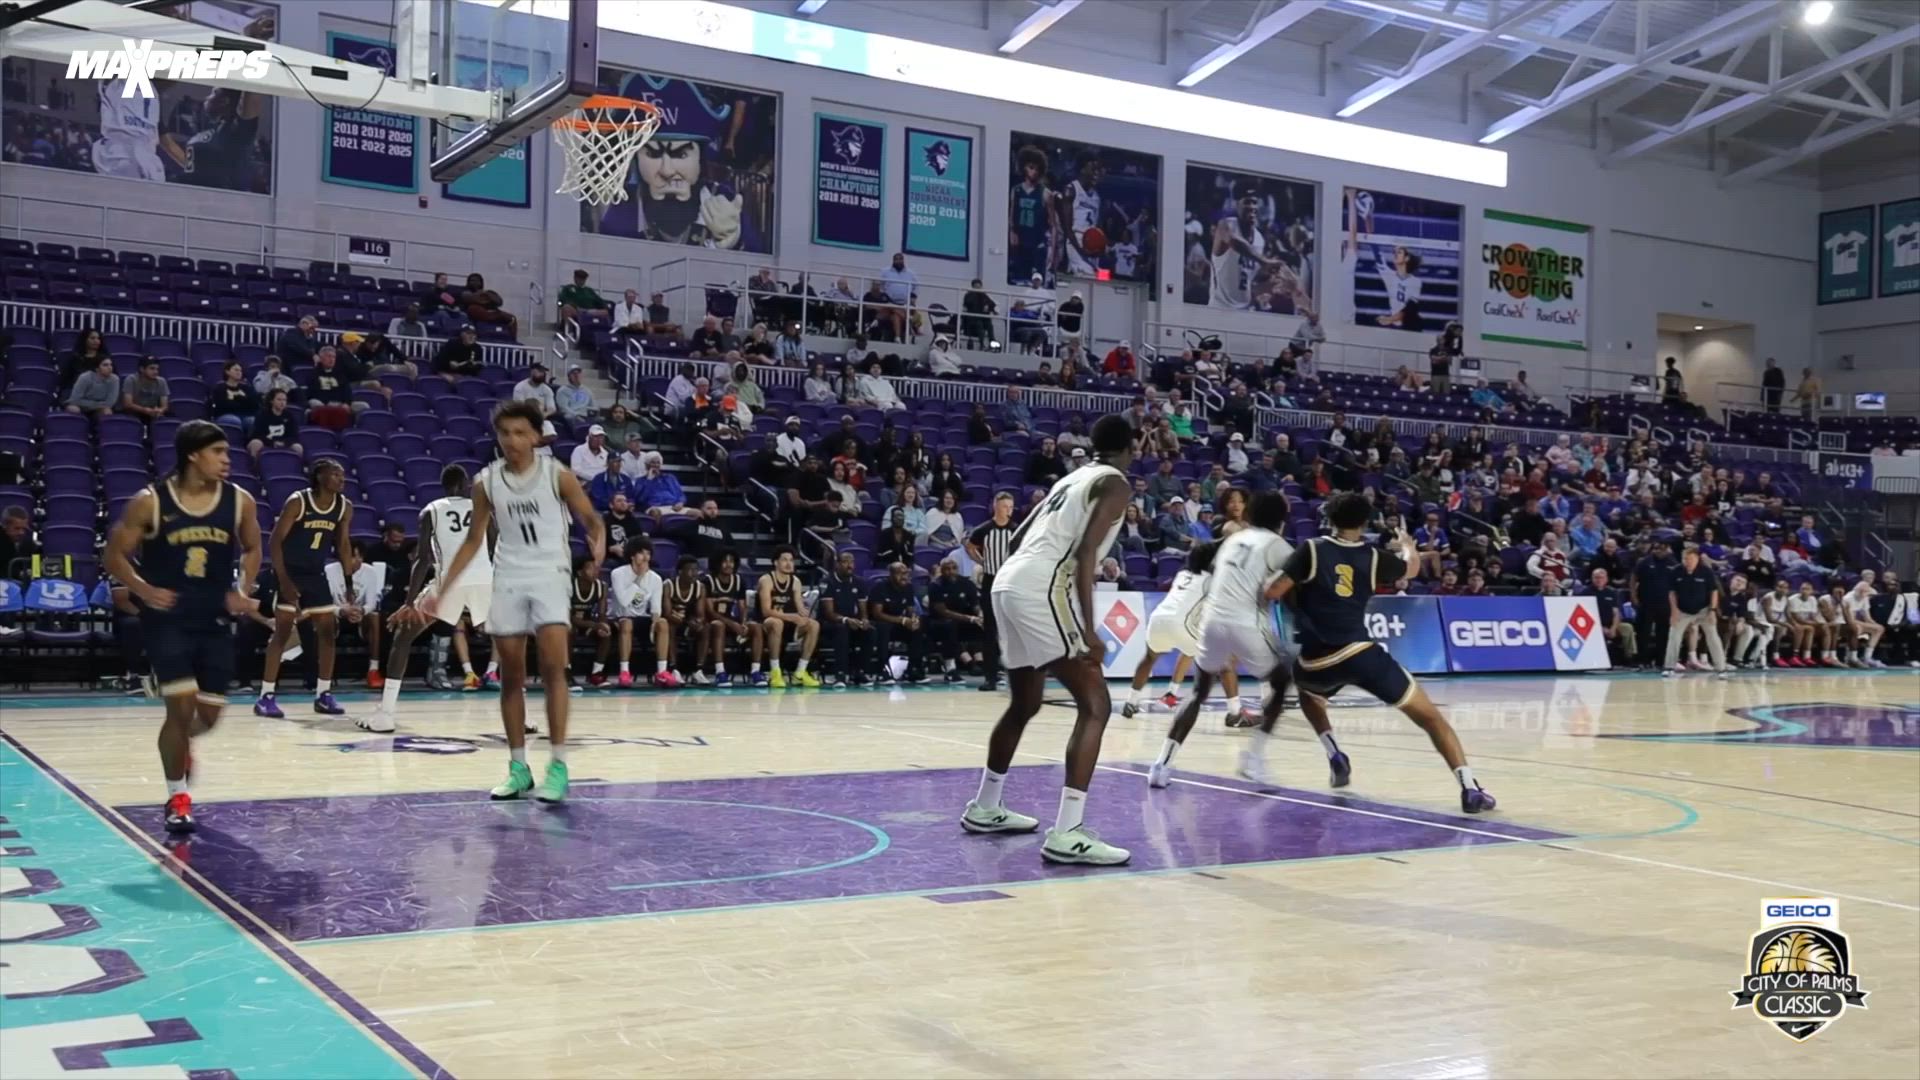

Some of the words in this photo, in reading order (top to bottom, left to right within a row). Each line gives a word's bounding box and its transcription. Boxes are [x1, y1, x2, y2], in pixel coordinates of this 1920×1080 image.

[333, 121, 358, 136] 2018
[361, 125, 386, 140] 2019
[388, 129, 413, 143] 2020
[333, 135, 358, 150] 2021
[361, 139, 386, 154] 2022
[388, 143, 413, 158] 2025
[819, 177, 879, 196] CHAMPIONS
[909, 202, 936, 215] 2018
[909, 214, 936, 227] 2020
[364, 241, 384, 254] 116
[1482, 244, 1584, 278] CROWTHER
[1489, 270, 1574, 300] ROOFING
[310, 532, 323, 550] 1
[519, 521, 538, 545] 11
[1334, 563, 1355, 598] 3
[1450, 620, 1547, 647] GEICO
